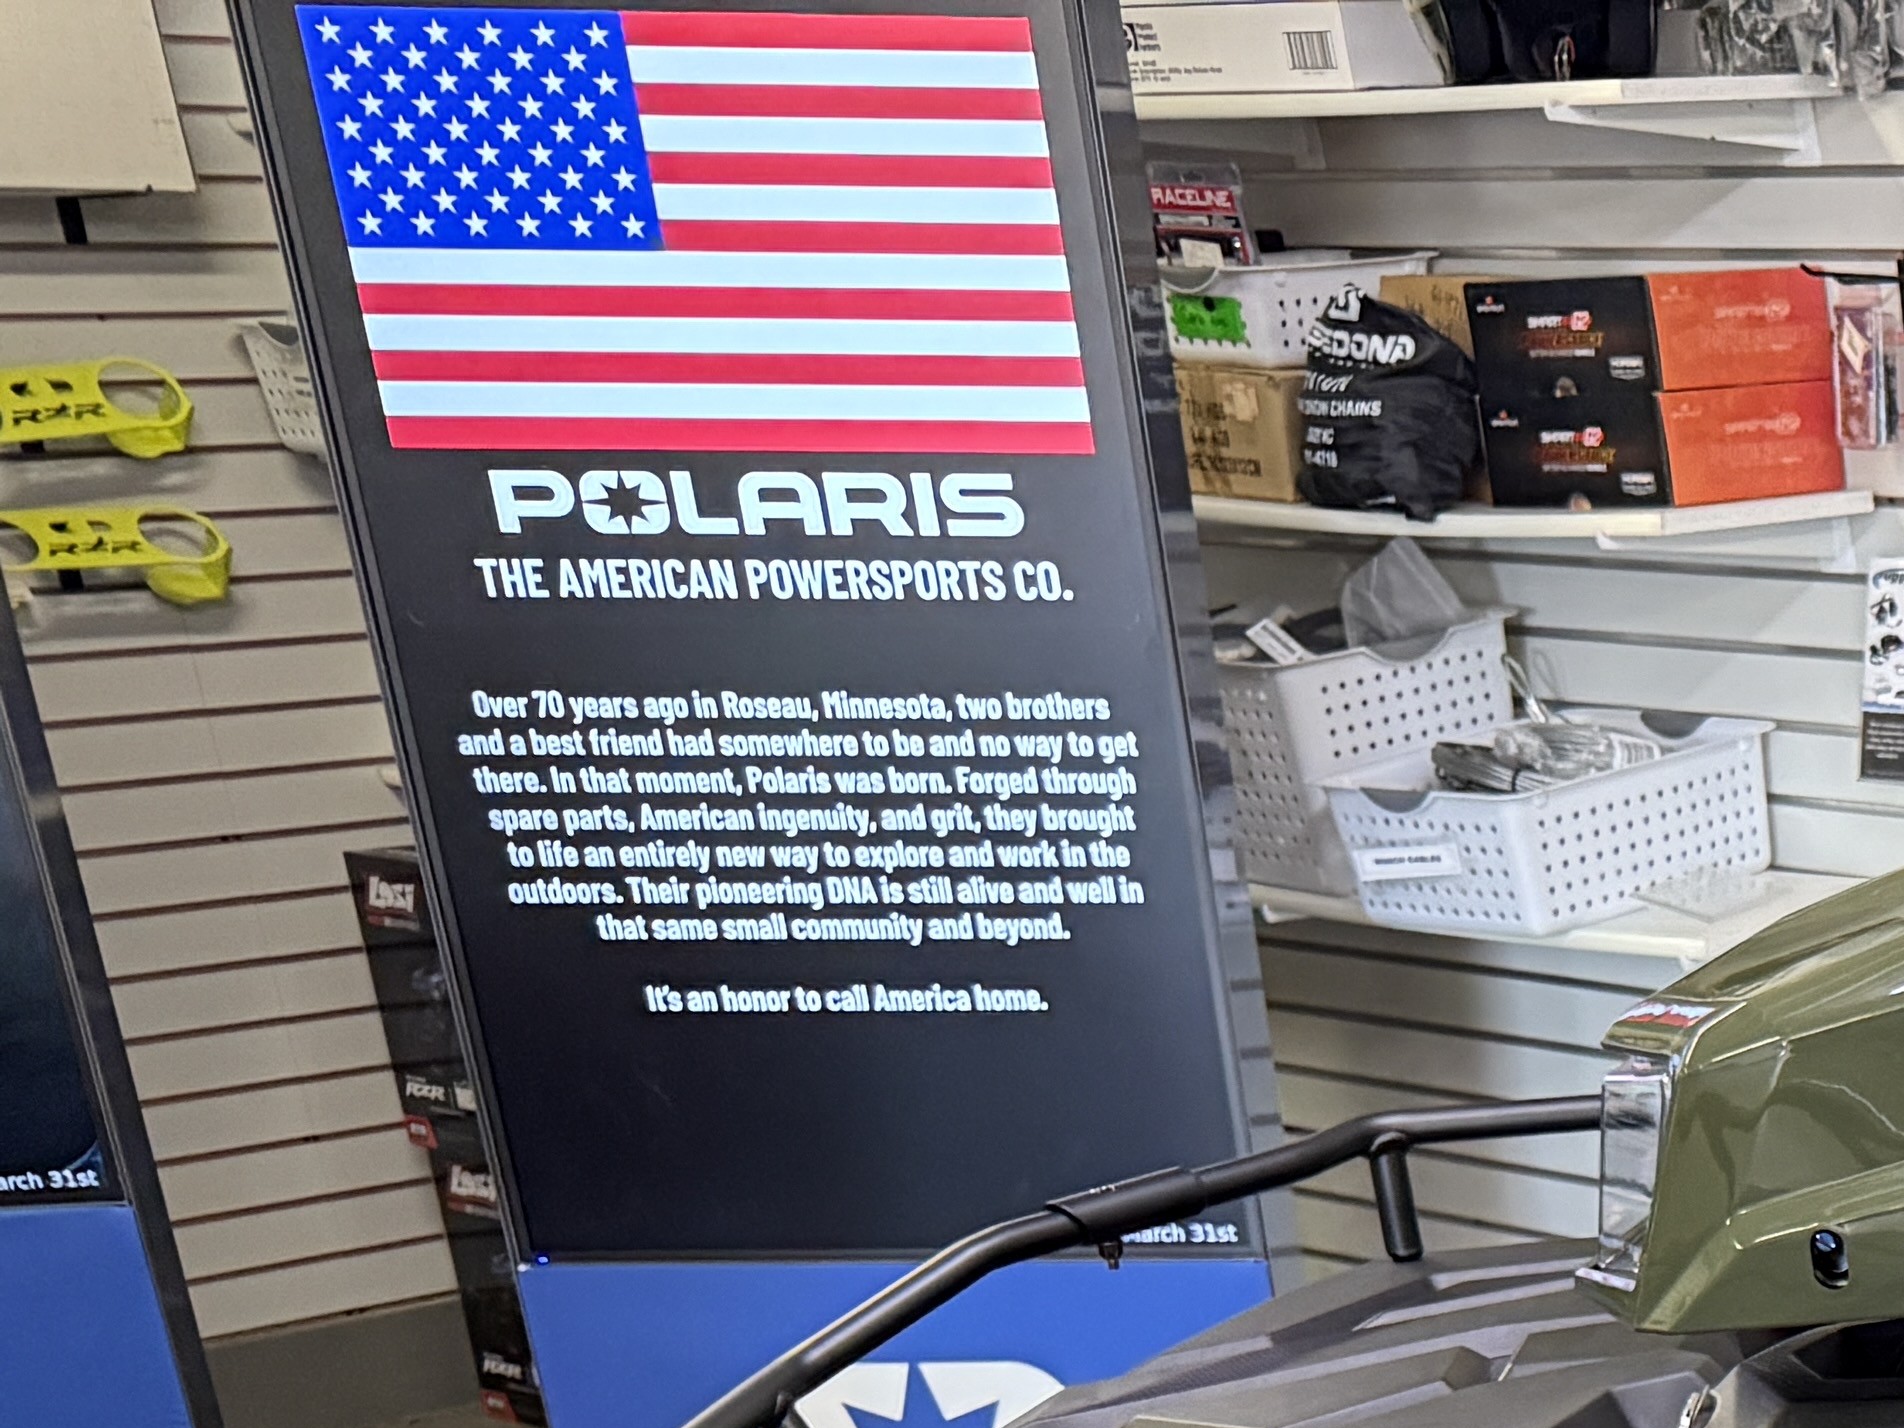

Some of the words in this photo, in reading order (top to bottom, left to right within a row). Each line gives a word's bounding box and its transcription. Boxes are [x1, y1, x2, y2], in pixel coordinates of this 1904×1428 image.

[1150, 186, 1232, 209] RACELINE
[487, 469, 1025, 537] POLARIS
[473, 558, 550, 598] THE
[559, 558, 739, 600] AMERICAN
[743, 558, 1007, 601] POWERSPORTS
[1012, 560, 1074, 602] CO.
[472, 690, 529, 718] Over
[531, 689, 565, 719] 70
[568, 696, 639, 725] years
[643, 696, 689, 726] ago
[691, 690, 719, 719] in
[720, 690, 819, 722] Roseau,
[821, 690, 953, 723] Minnesota,
[955, 693, 1003, 720] two
[1004, 691, 1111, 720] brothers
[458, 728, 505, 756] and
[509, 734, 527, 756] a
[528, 728, 587, 756] best
[588, 727, 665, 756] friend
[666, 727, 715, 757] had
[718, 728, 859, 757] somewhere
[861, 730, 890, 757] to
[892, 728, 925, 757] be
[929, 728, 976, 757] and
[978, 735, 1011, 757] no
[1013, 735, 1063, 764] way
[1066, 731, 1095, 757] to
[1097, 731, 1139, 764] get
[472, 766, 548, 793] there.
[549, 765, 577, 793] In
[579, 766, 632, 793] that
[635, 767, 743, 797] moment,
[745, 765, 832, 794] Polaris
[834, 772, 886, 794] was
[887, 766, 953, 794] born.
[955, 766, 1039, 801] Forged
[1041, 766, 1137, 801] through
[488, 809, 559, 837] spare
[562, 804, 635, 836] parts,
[640, 802, 755, 831] American
[756, 802, 877, 837] ingenuity,
[881, 803, 927, 831] and
[930, 802, 982, 838] grit,
[983, 803, 1037, 838] they
[1041, 803, 1137, 838] brought
[506, 841, 535, 867] to
[536, 839, 580, 867] life
[583, 845, 616, 867] an
[619, 839, 711, 874] entirely
[715, 845, 766, 868] new
[769, 845, 819, 874] way
[822, 841, 851, 868] to
[853, 839, 945, 874] explore
[948, 839, 995, 868] and
[996, 839, 1060, 868] work
[1059, 838, 1087, 868] in
[1088, 839, 1131, 868] the
[508, 876, 624, 904] outdoors.
[624, 875, 690, 904] Their
[695, 875, 825, 911] pioneering
[826, 876, 878, 904] DNA
[879, 875, 905, 904] is
[907, 875, 954, 904] still
[956, 875, 1015, 904] alive
[1018, 876, 1064, 904] and
[1065, 875, 1117, 904] well
[1118, 875, 1145, 904] in
[596, 913, 649, 940] that
[651, 918, 718, 940] same
[721, 912, 788, 940] small
[791, 912, 923, 946] community
[928, 912, 974, 940] and
[975, 912, 1071, 946] beyond.
[687, 991, 719, 1012] an
[720, 984, 791, 1012] honor
[794, 986, 822, 1012] to
[825, 984, 870, 1012] call
[874, 983, 972, 1012] America
[973, 983, 1049, 1011] home.
[47, 1168, 101, 1189] 31st
[1188, 1222, 1239, 1243] 31st
